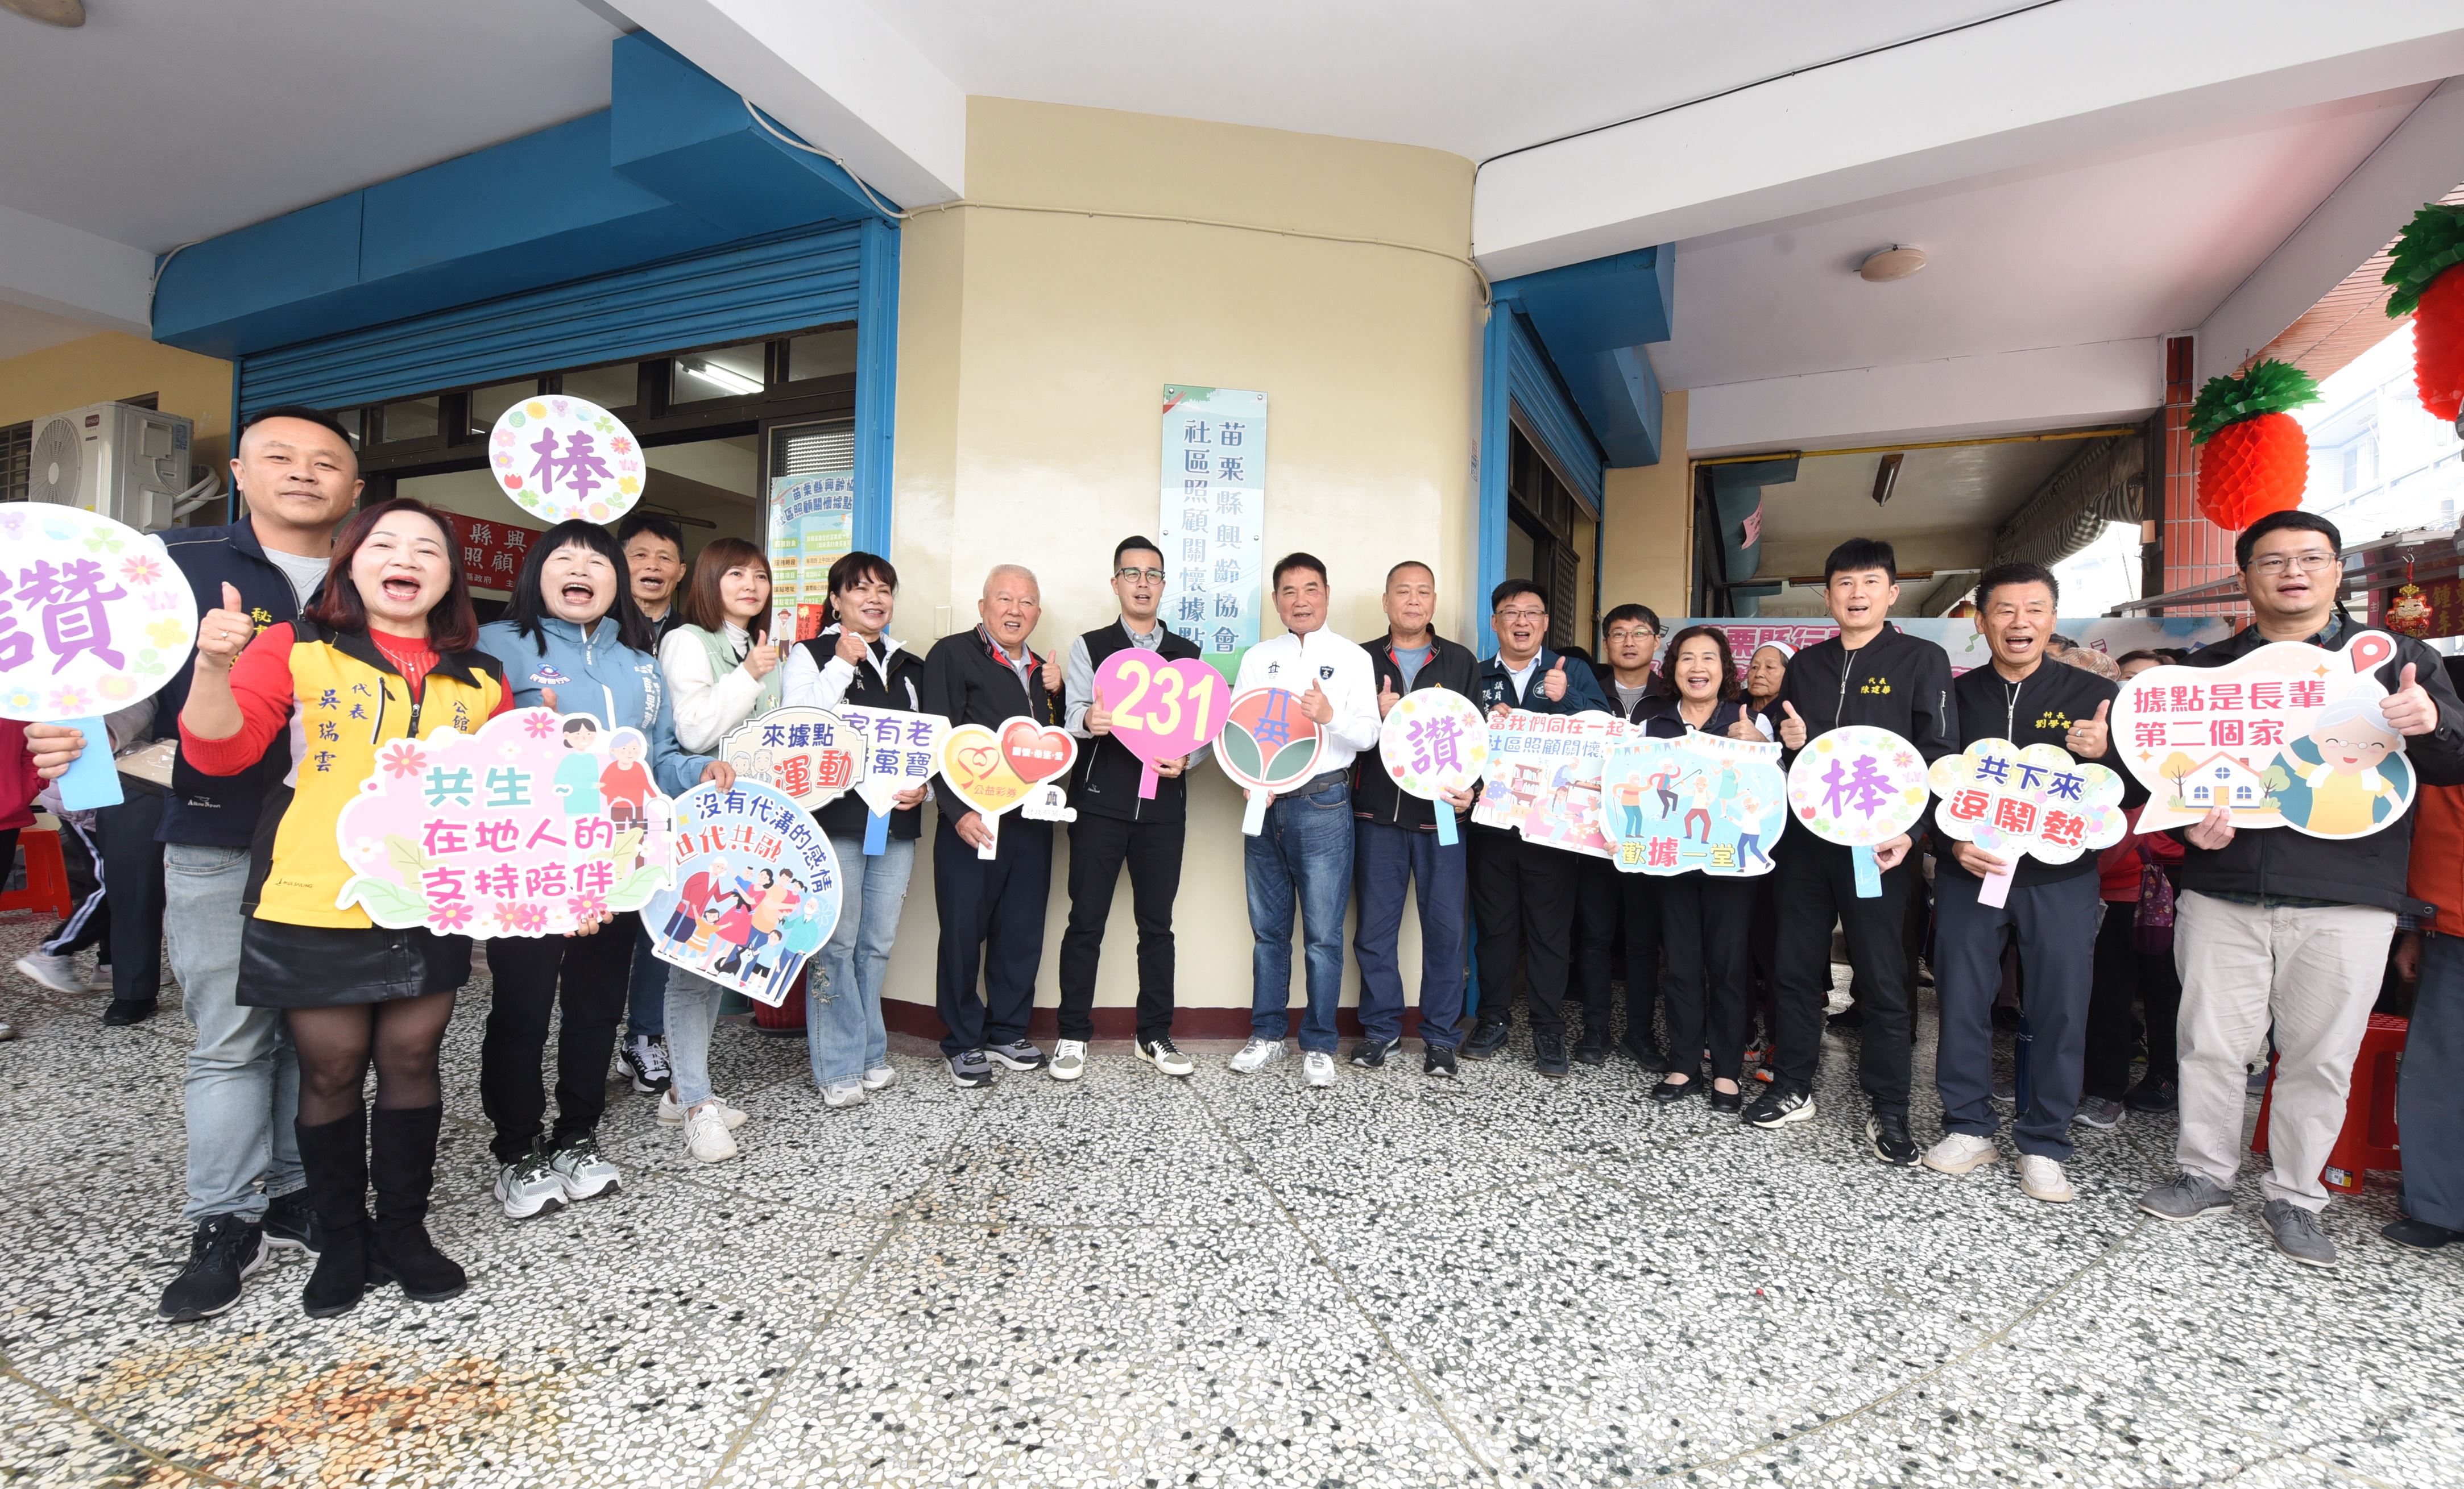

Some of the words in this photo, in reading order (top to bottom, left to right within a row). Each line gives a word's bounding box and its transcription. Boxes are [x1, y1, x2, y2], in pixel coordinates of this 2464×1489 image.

[530, 428, 614, 501] 棒
[774, 496, 852, 528] 社區照顧關懷據點
[1178, 420, 1212, 652] 社區照顧關懷據點
[1210, 421, 1246, 653] 苗栗縣興齡協會
[0, 558, 127, 675] 讚
[347, 682, 371, 720] 代表
[1111, 660, 1215, 742] 231
[1493, 681, 1504, 701] 議員
[2133, 680, 2326, 714] 據點是長輩
[314, 689, 341, 772] 吳瑞雲
[453, 700, 470, 732] 公館
[761, 723, 834, 748] 來據點
[2043, 711, 2065, 719] 村長
[2134, 719, 2285, 748] 第二個家
[865, 748, 931, 778] 萬寶
[1405, 715, 1464, 776] 讚
[1488, 734, 1610, 759] 社區照顧關懷
[773, 749, 854, 798] 運動
[974, 783, 1017, 798] 公益彩券
[1821, 754, 1899, 821] 棒
[1977, 755, 2084, 802] 共下來
[423, 816, 614, 857] 在地人的
[1949, 789, 2085, 848] 逗鬧熱
[676, 824, 782, 865] 世代共融
[695, 790, 833, 894] 沒有代溝的感情
[1621, 836, 1736, 868] 歡據一堂
[423, 860, 614, 906] 支持陪伴
